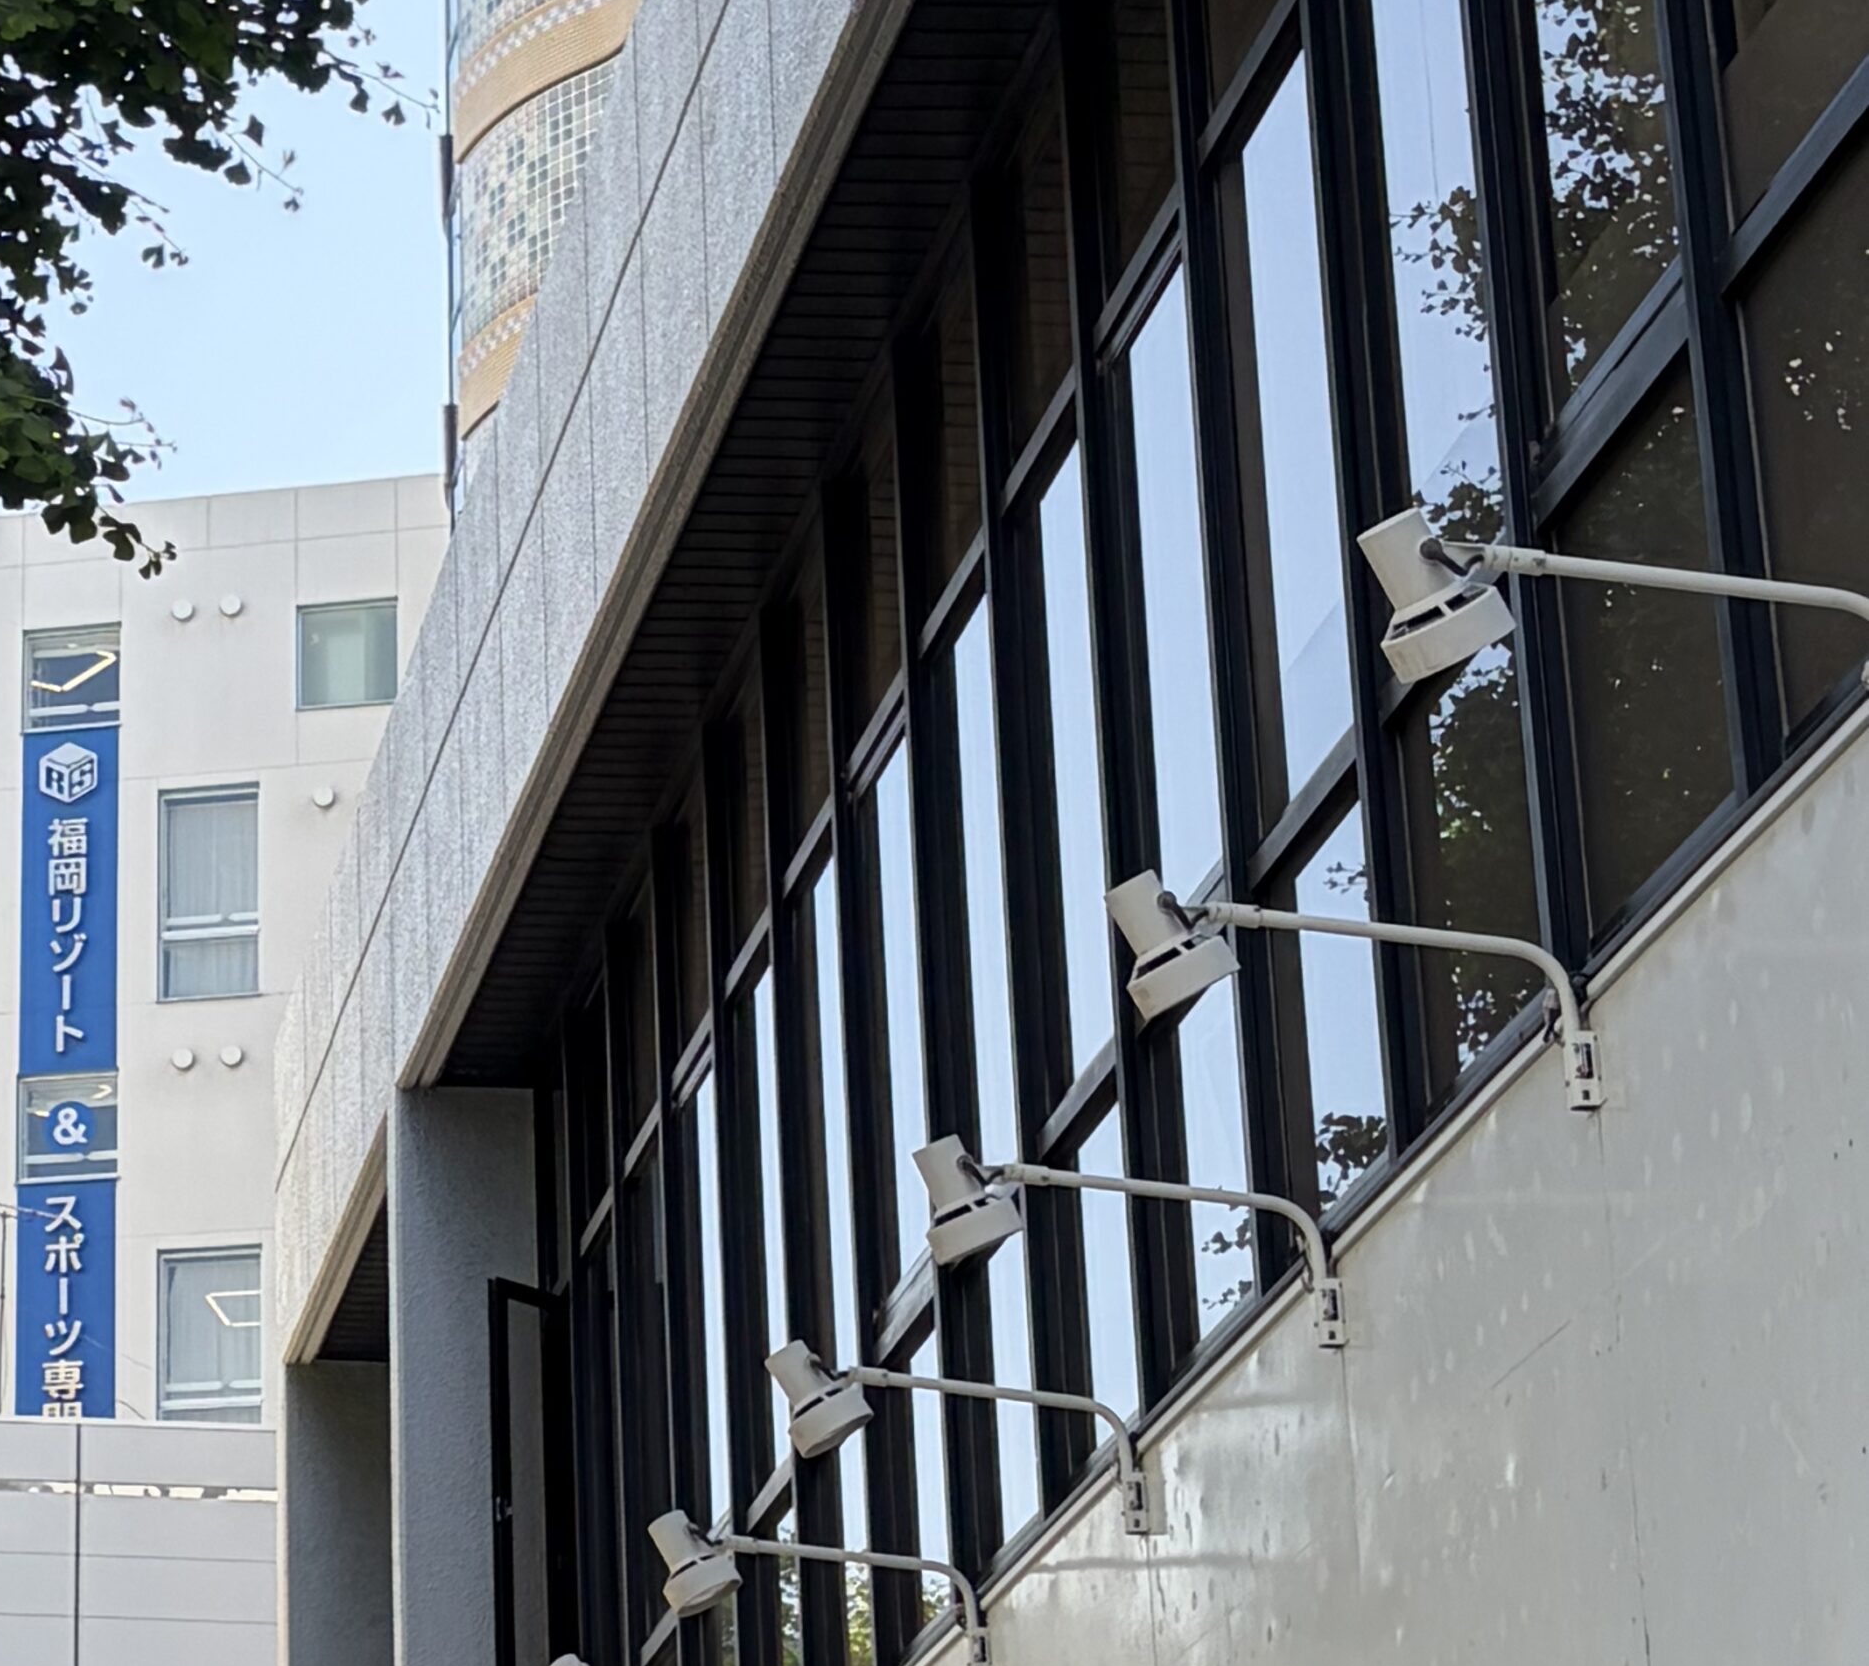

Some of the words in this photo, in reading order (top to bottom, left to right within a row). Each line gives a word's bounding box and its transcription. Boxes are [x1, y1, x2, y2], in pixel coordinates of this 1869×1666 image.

[48, 817, 88, 1054] 福岡リゾート
[52, 1106, 88, 1146] &
